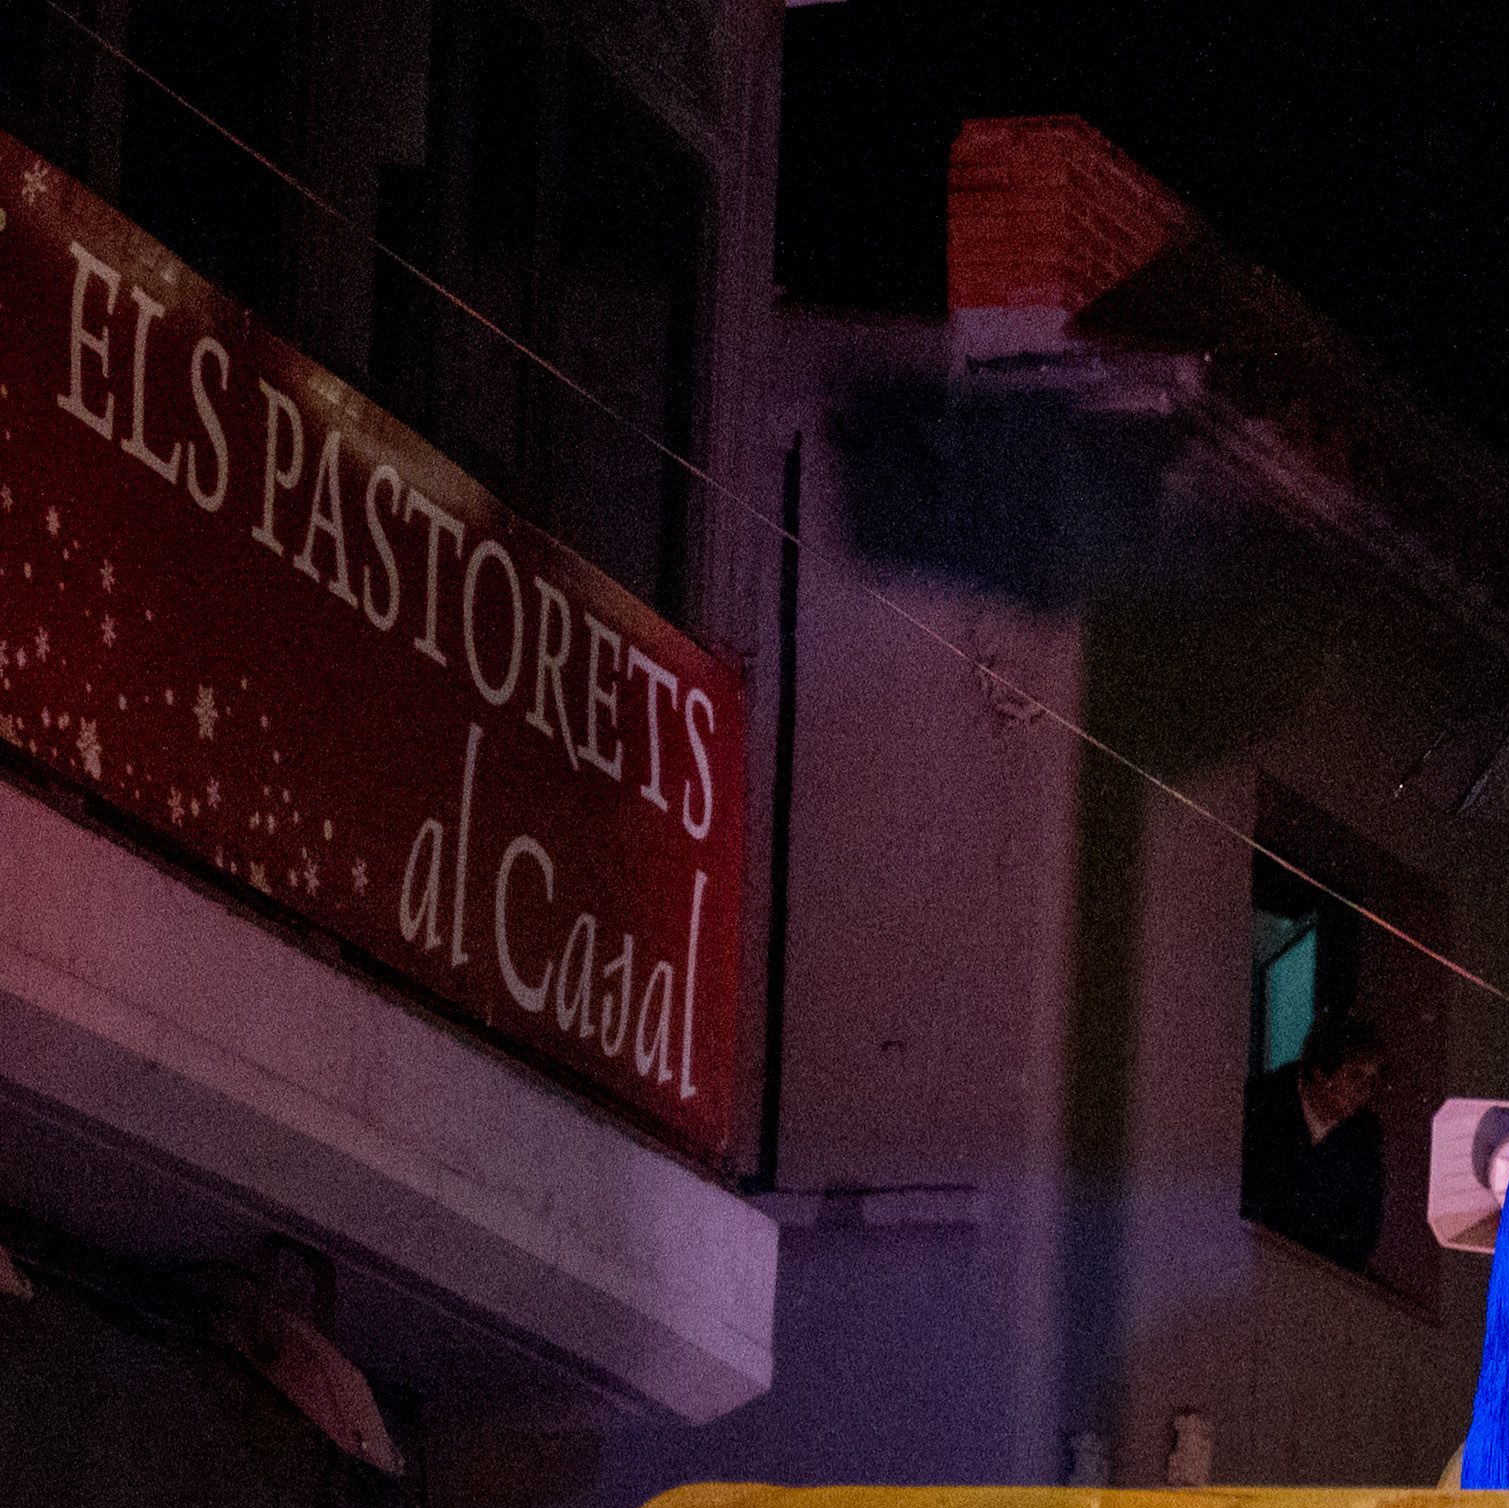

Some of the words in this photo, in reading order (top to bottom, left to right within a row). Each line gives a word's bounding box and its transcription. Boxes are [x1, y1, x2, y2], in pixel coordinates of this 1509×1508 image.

[57, 240, 230, 513] ELS
[251, 377, 716, 840] PASTORETS
[399, 722, 484, 967] al
[494, 834, 709, 1100] Casal
